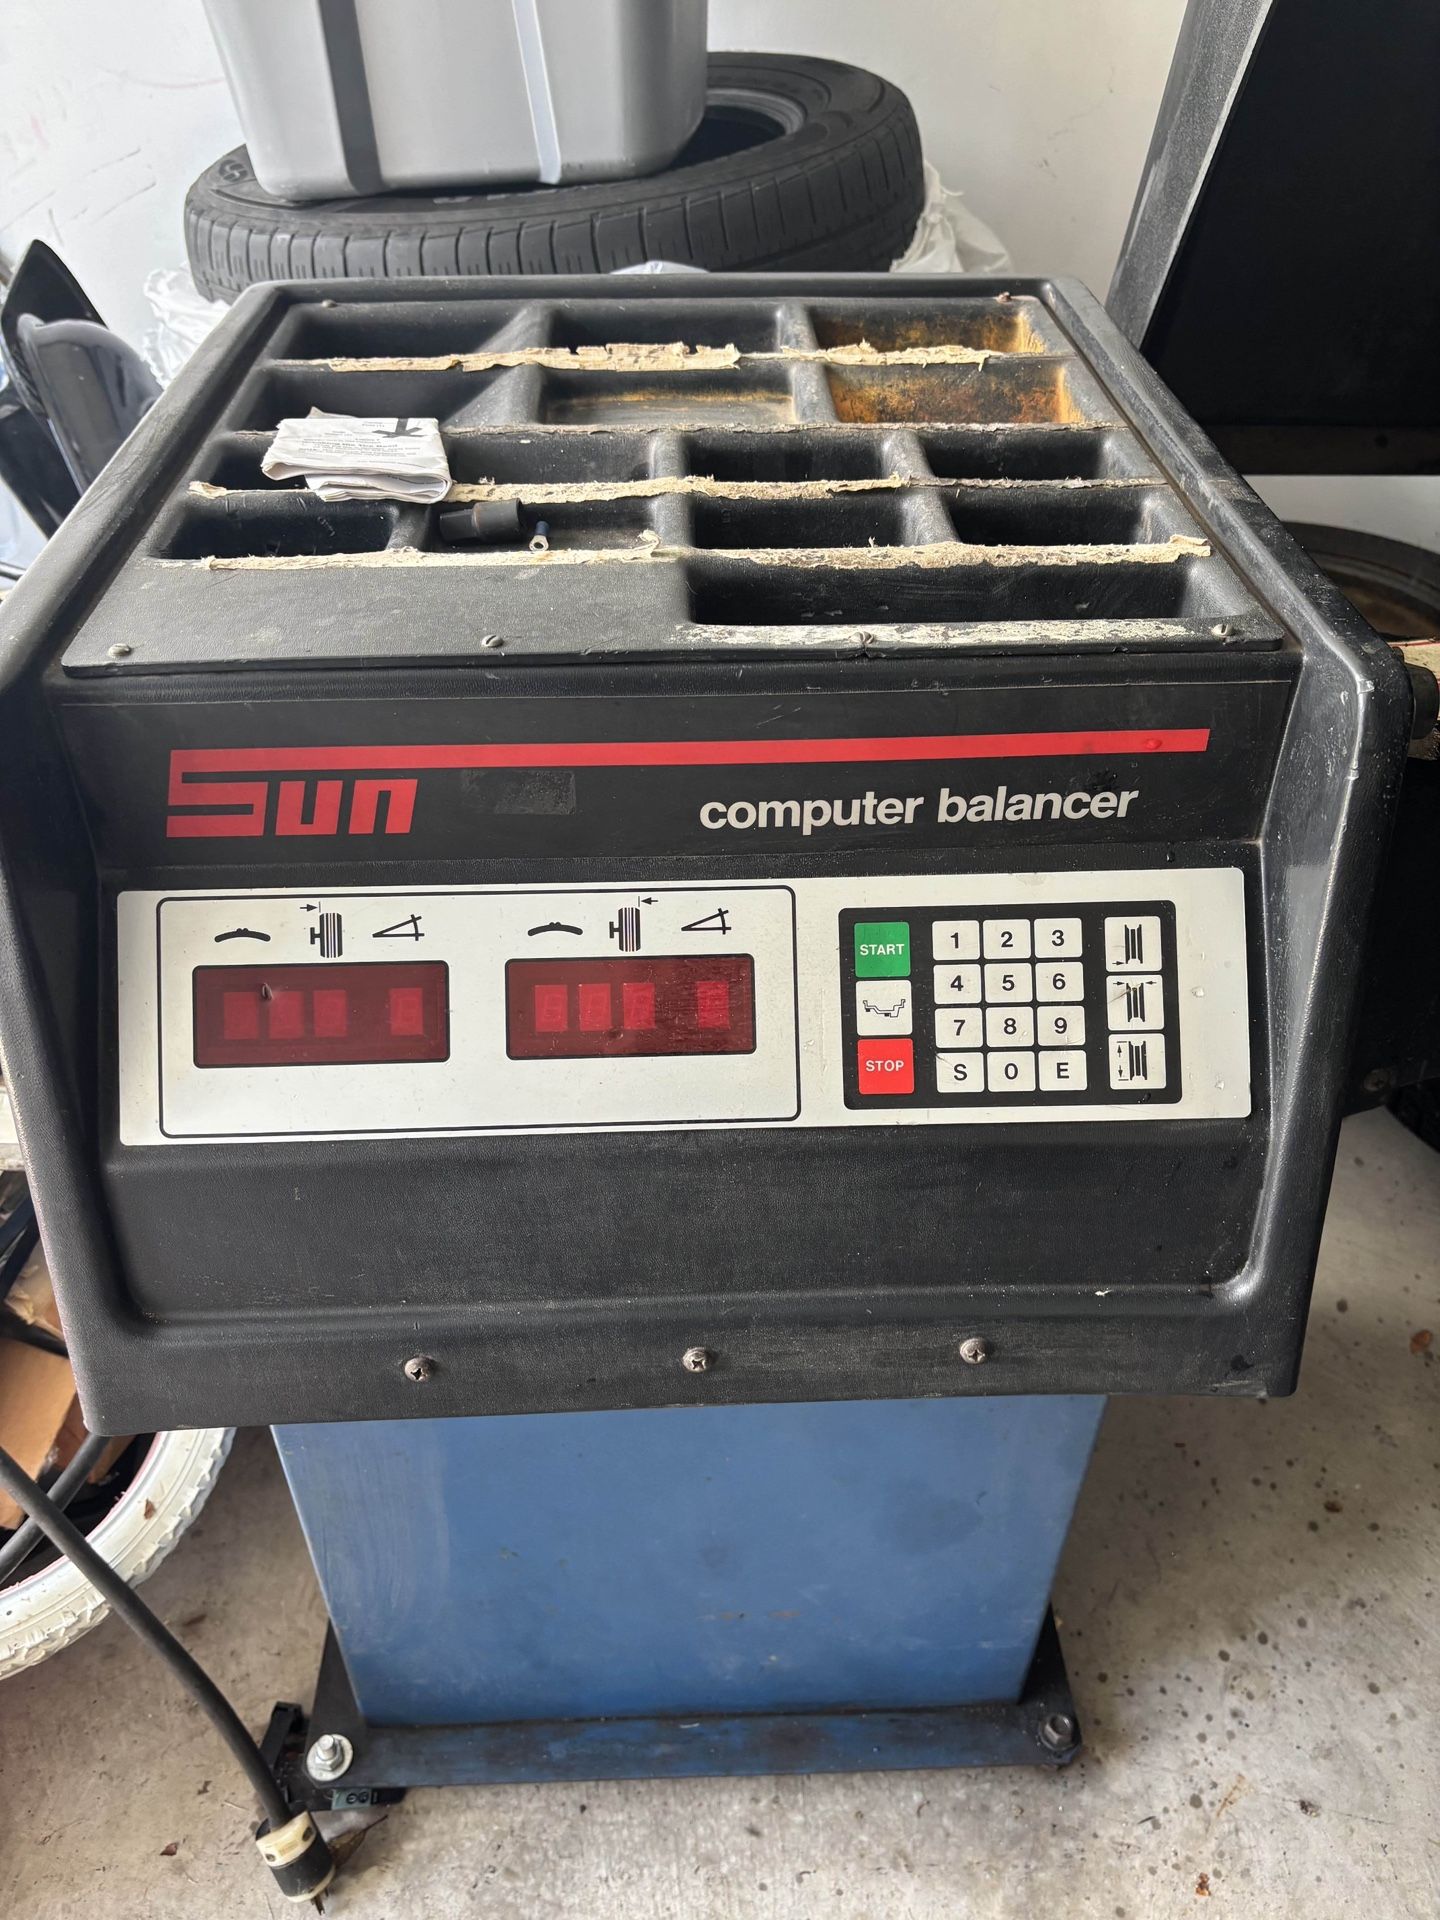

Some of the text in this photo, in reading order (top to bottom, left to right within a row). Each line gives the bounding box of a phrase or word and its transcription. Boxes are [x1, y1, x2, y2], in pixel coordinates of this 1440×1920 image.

[699, 785, 1140, 836] computer balancer
[950, 929, 1065, 949] 1 2 3
[859, 943, 905, 957] START
[950, 973, 1066, 992] 4 5 6
[953, 1017, 1068, 1036] 7 8 9
[865, 1059, 905, 1072] STOP
[953, 1063, 968, 1081] S
[1056, 1062, 1070, 1079] E
